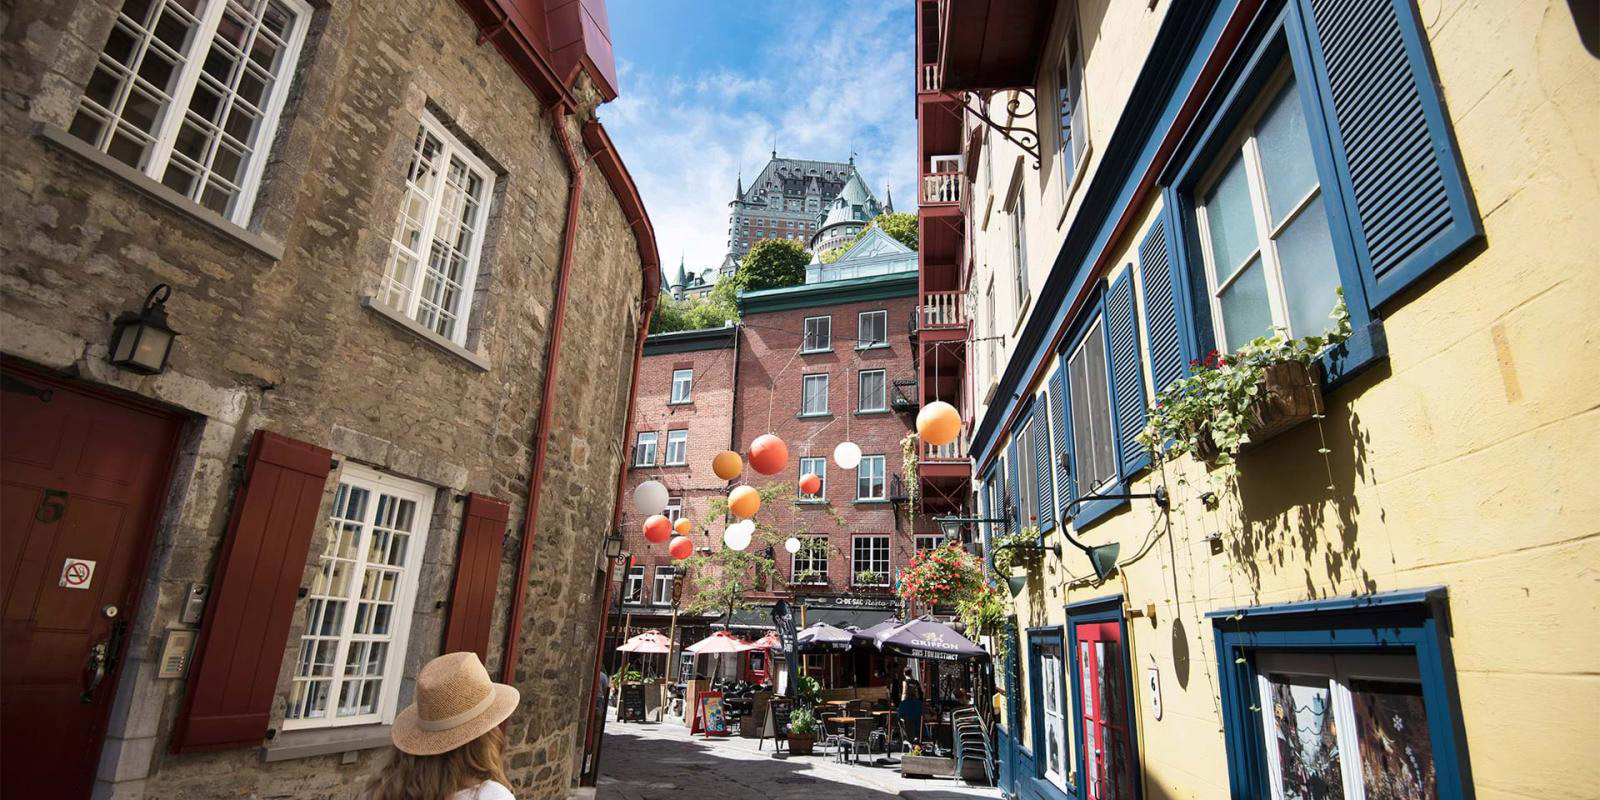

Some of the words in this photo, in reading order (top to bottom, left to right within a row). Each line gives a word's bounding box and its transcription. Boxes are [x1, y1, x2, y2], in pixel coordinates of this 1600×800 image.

[35, 488, 69, 524] 5
[911, 639, 959, 650] GRIFFON
[1151, 677, 1156, 692] 6
